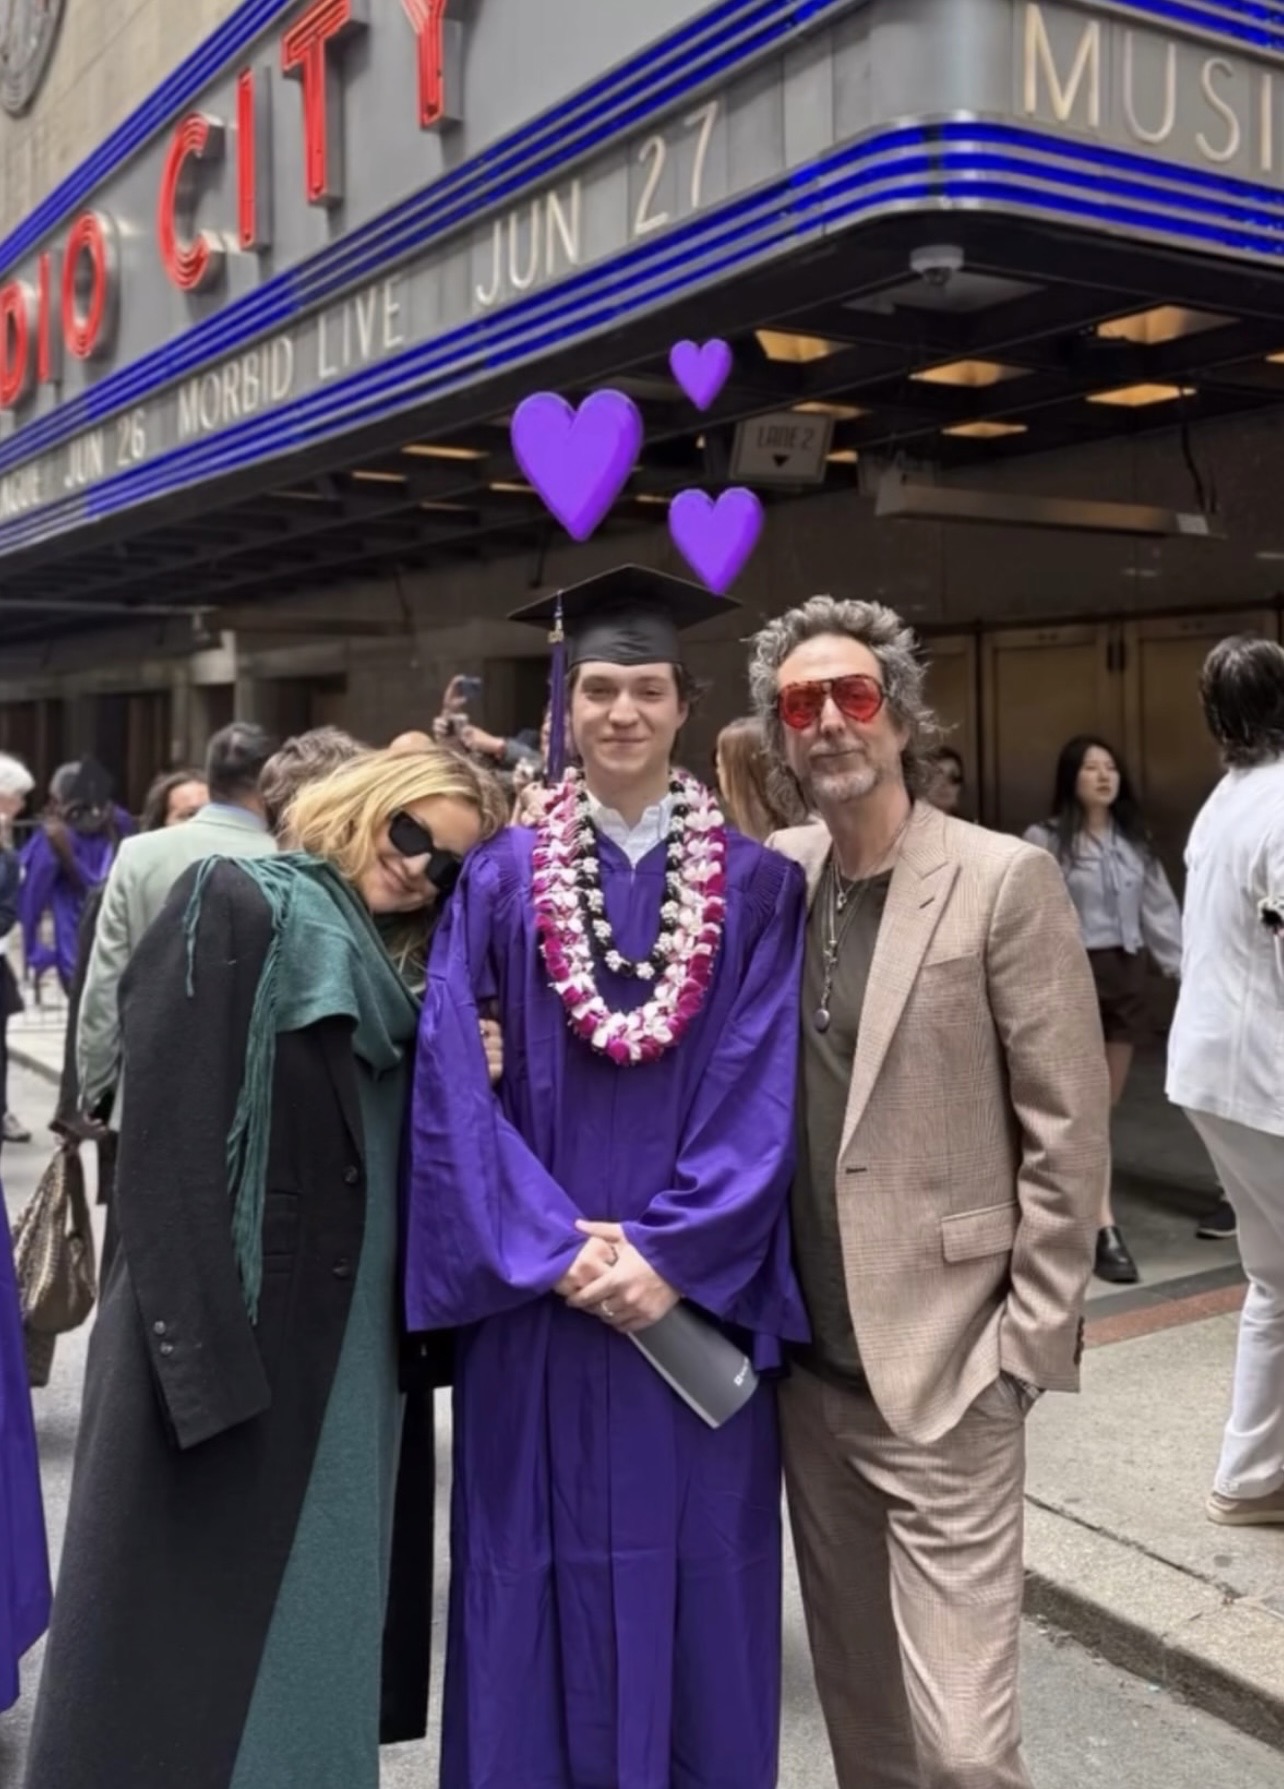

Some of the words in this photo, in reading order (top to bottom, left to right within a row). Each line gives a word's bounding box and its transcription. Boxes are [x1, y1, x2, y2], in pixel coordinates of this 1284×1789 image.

[157, 0, 446, 291] CITY
[1023, 4, 1272, 171] MUSI
[64, 427, 104, 489] JUN
[117, 407, 146, 467] 26
[178, 336, 293, 437] MORBID
[318, 279, 403, 379] LIVE
[476, 178, 581, 305] JUN
[633, 100, 719, 236] 27
[800, 426, 816, 451] 2
